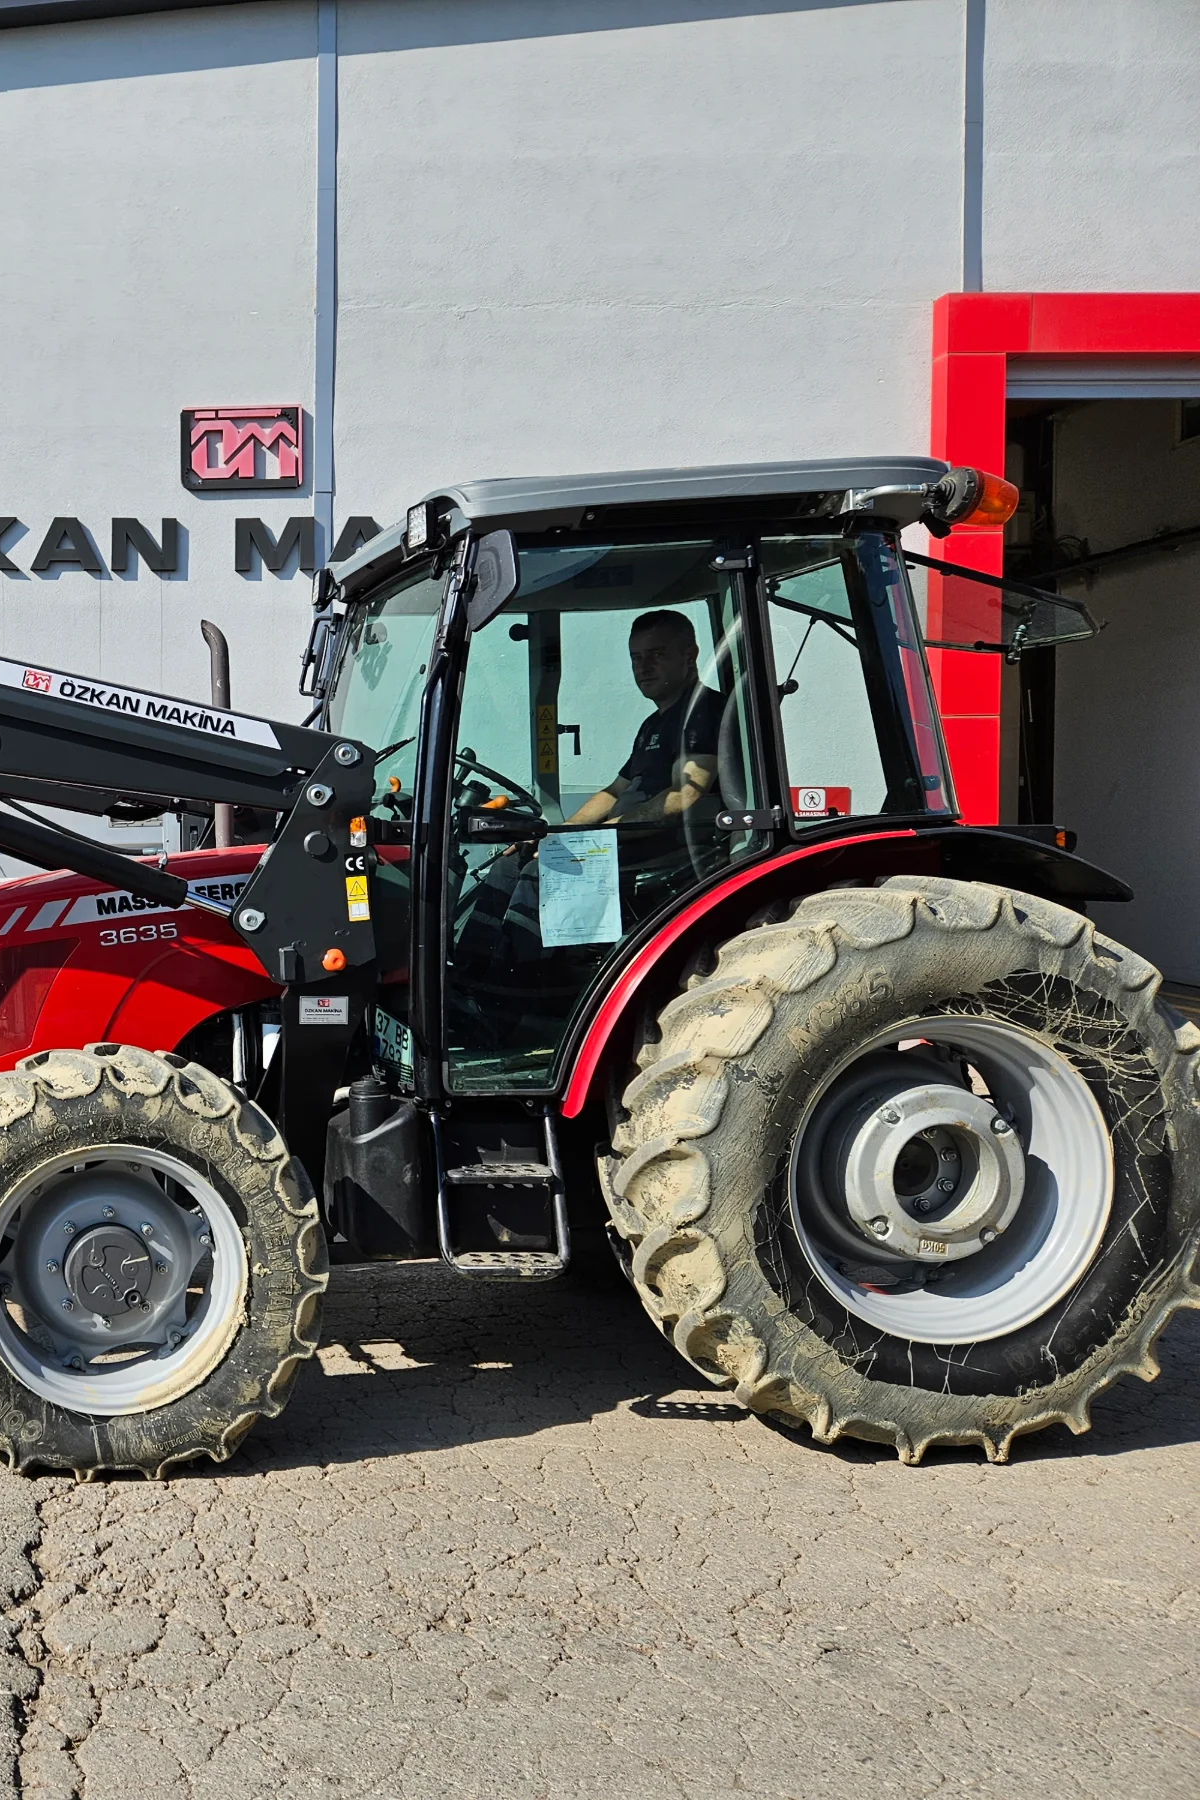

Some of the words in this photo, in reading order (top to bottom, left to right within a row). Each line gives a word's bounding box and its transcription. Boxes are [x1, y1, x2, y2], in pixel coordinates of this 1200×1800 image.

[59, 679, 141, 714] ÖZKAN
[145, 701, 236, 737] MAKİNA
[345, 856, 365, 872] CE
[96, 894, 167, 916] MASS
[195, 882, 246, 901] FERG
[99, 922, 178, 946] 3635
[376, 1011, 391, 1036] 37
[395, 1023, 409, 1051] BB
